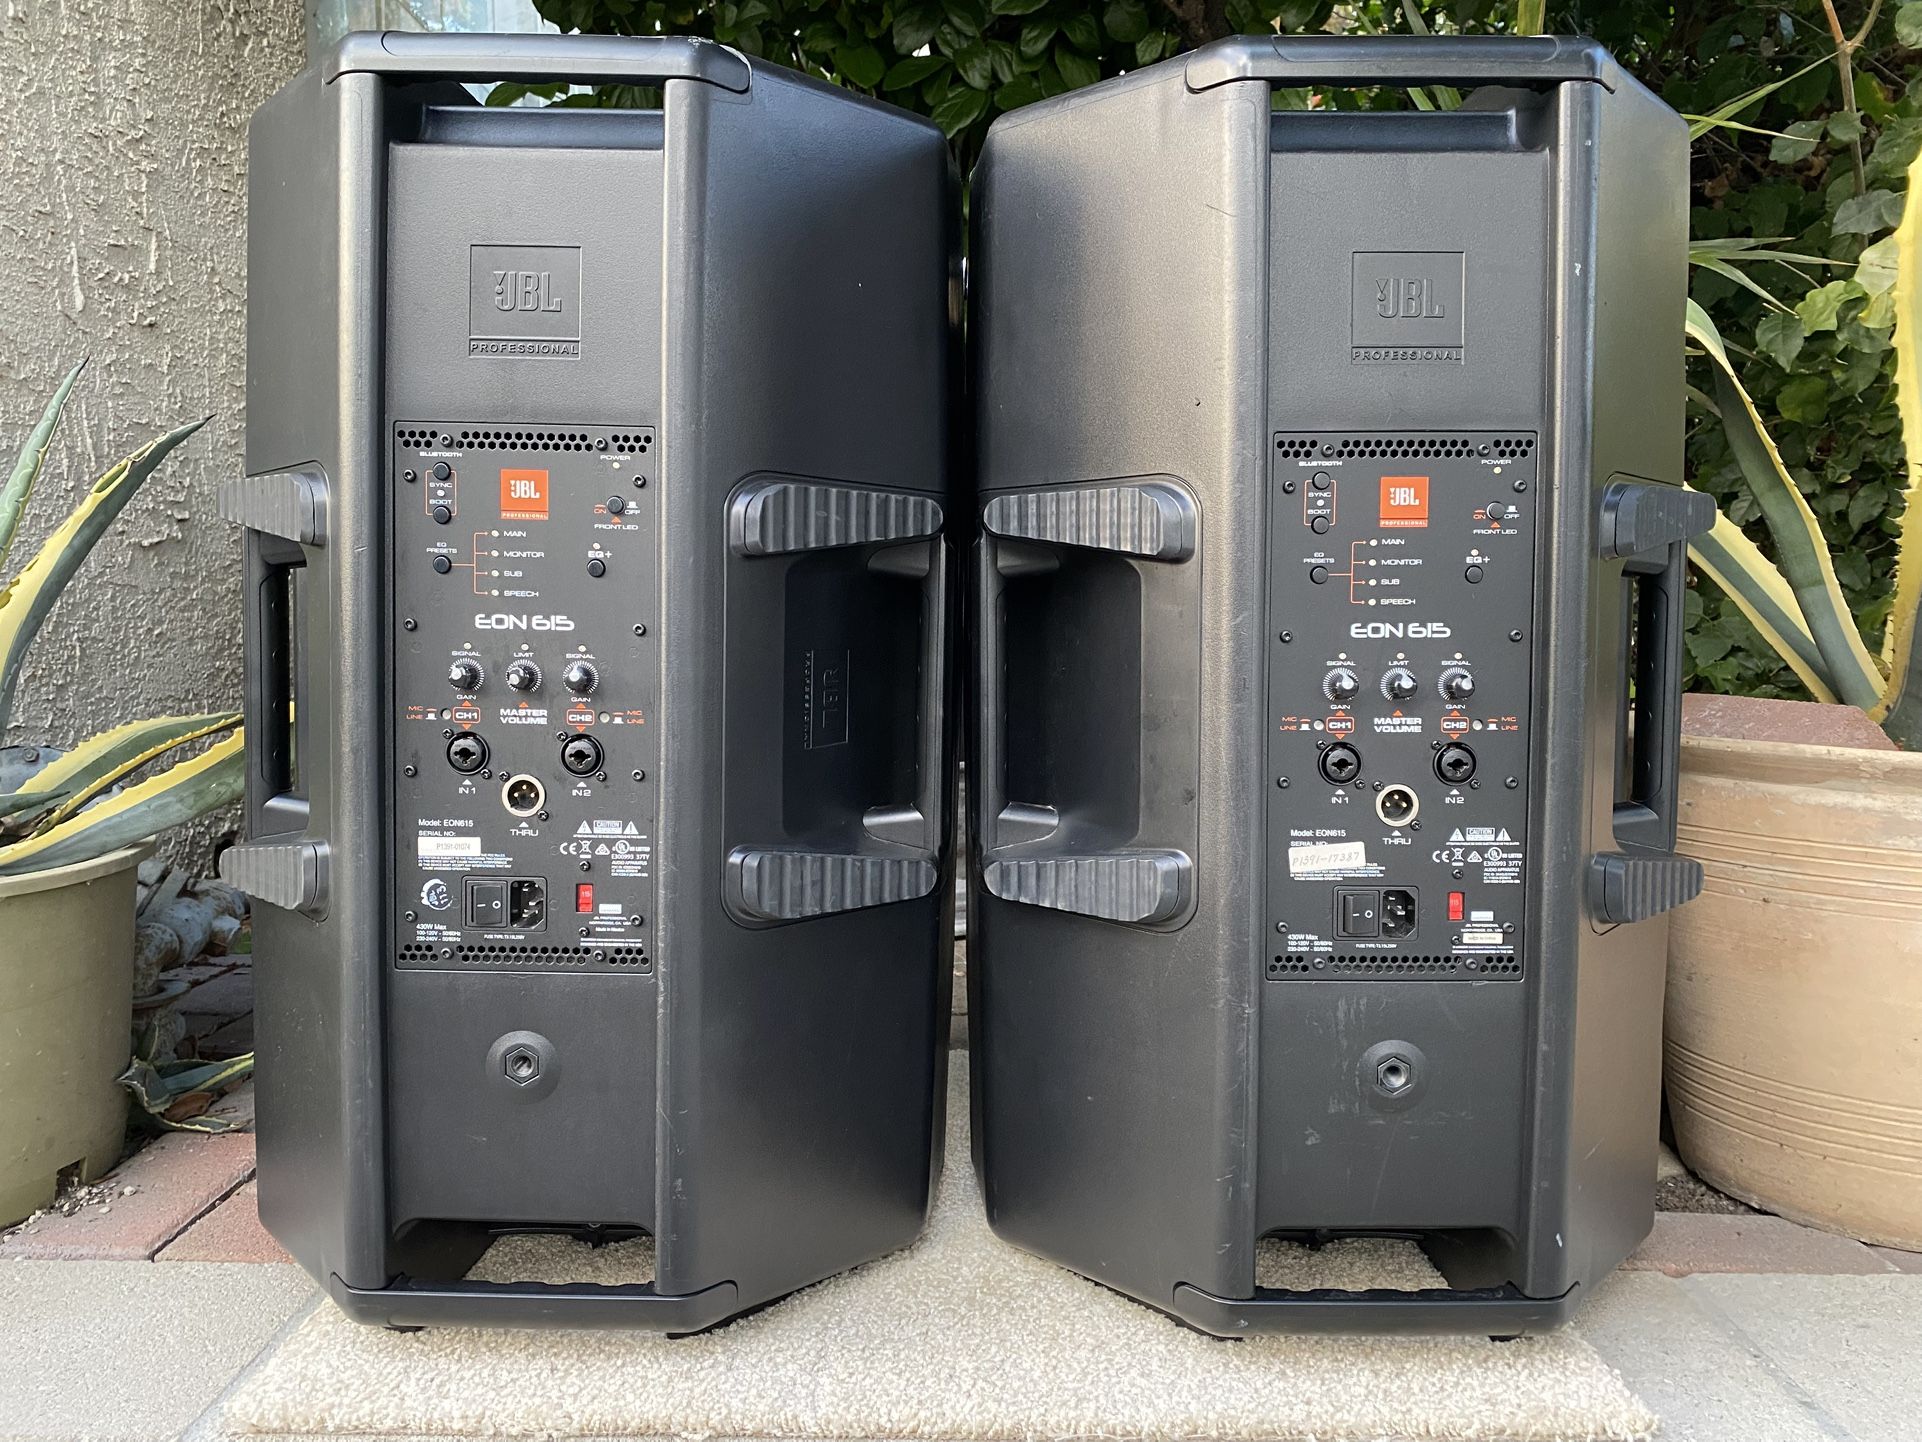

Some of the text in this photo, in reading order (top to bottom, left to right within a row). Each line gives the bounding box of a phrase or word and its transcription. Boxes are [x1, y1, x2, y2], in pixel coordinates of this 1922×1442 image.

[493, 271, 562, 313] JBL
[1376, 279, 1445, 319] JBL
[471, 343, 580, 355] PROFESSIONAL
[1353, 351, 1462, 361] PROFESSIONAL
[511, 480, 540, 499] JBL
[1390, 487, 1419, 506] JBL
[475, 613, 575, 631] EON 615
[1350, 622, 1451, 638] EON 615
[455, 711, 478, 719] CH1
[500, 708, 548, 717] MASTER
[500, 716, 548, 725] VOLUME
[569, 713, 592, 722] CH2
[1374, 717, 1422, 725] MASTER
[1328, 721, 1352, 730] CH1
[1374, 725, 1422, 733] VOLUME
[1443, 721, 1468, 730] CH2
[418, 819, 474, 828] Model: EON615
[510, 829, 539, 837] THRU
[1290, 829, 1346, 838] Model: EON615
[1382, 837, 1412, 845] THRU
[560, 842, 578, 856] CE
[1433, 850, 1450, 863] CE
[1306, 934, 1319, 942] Max
